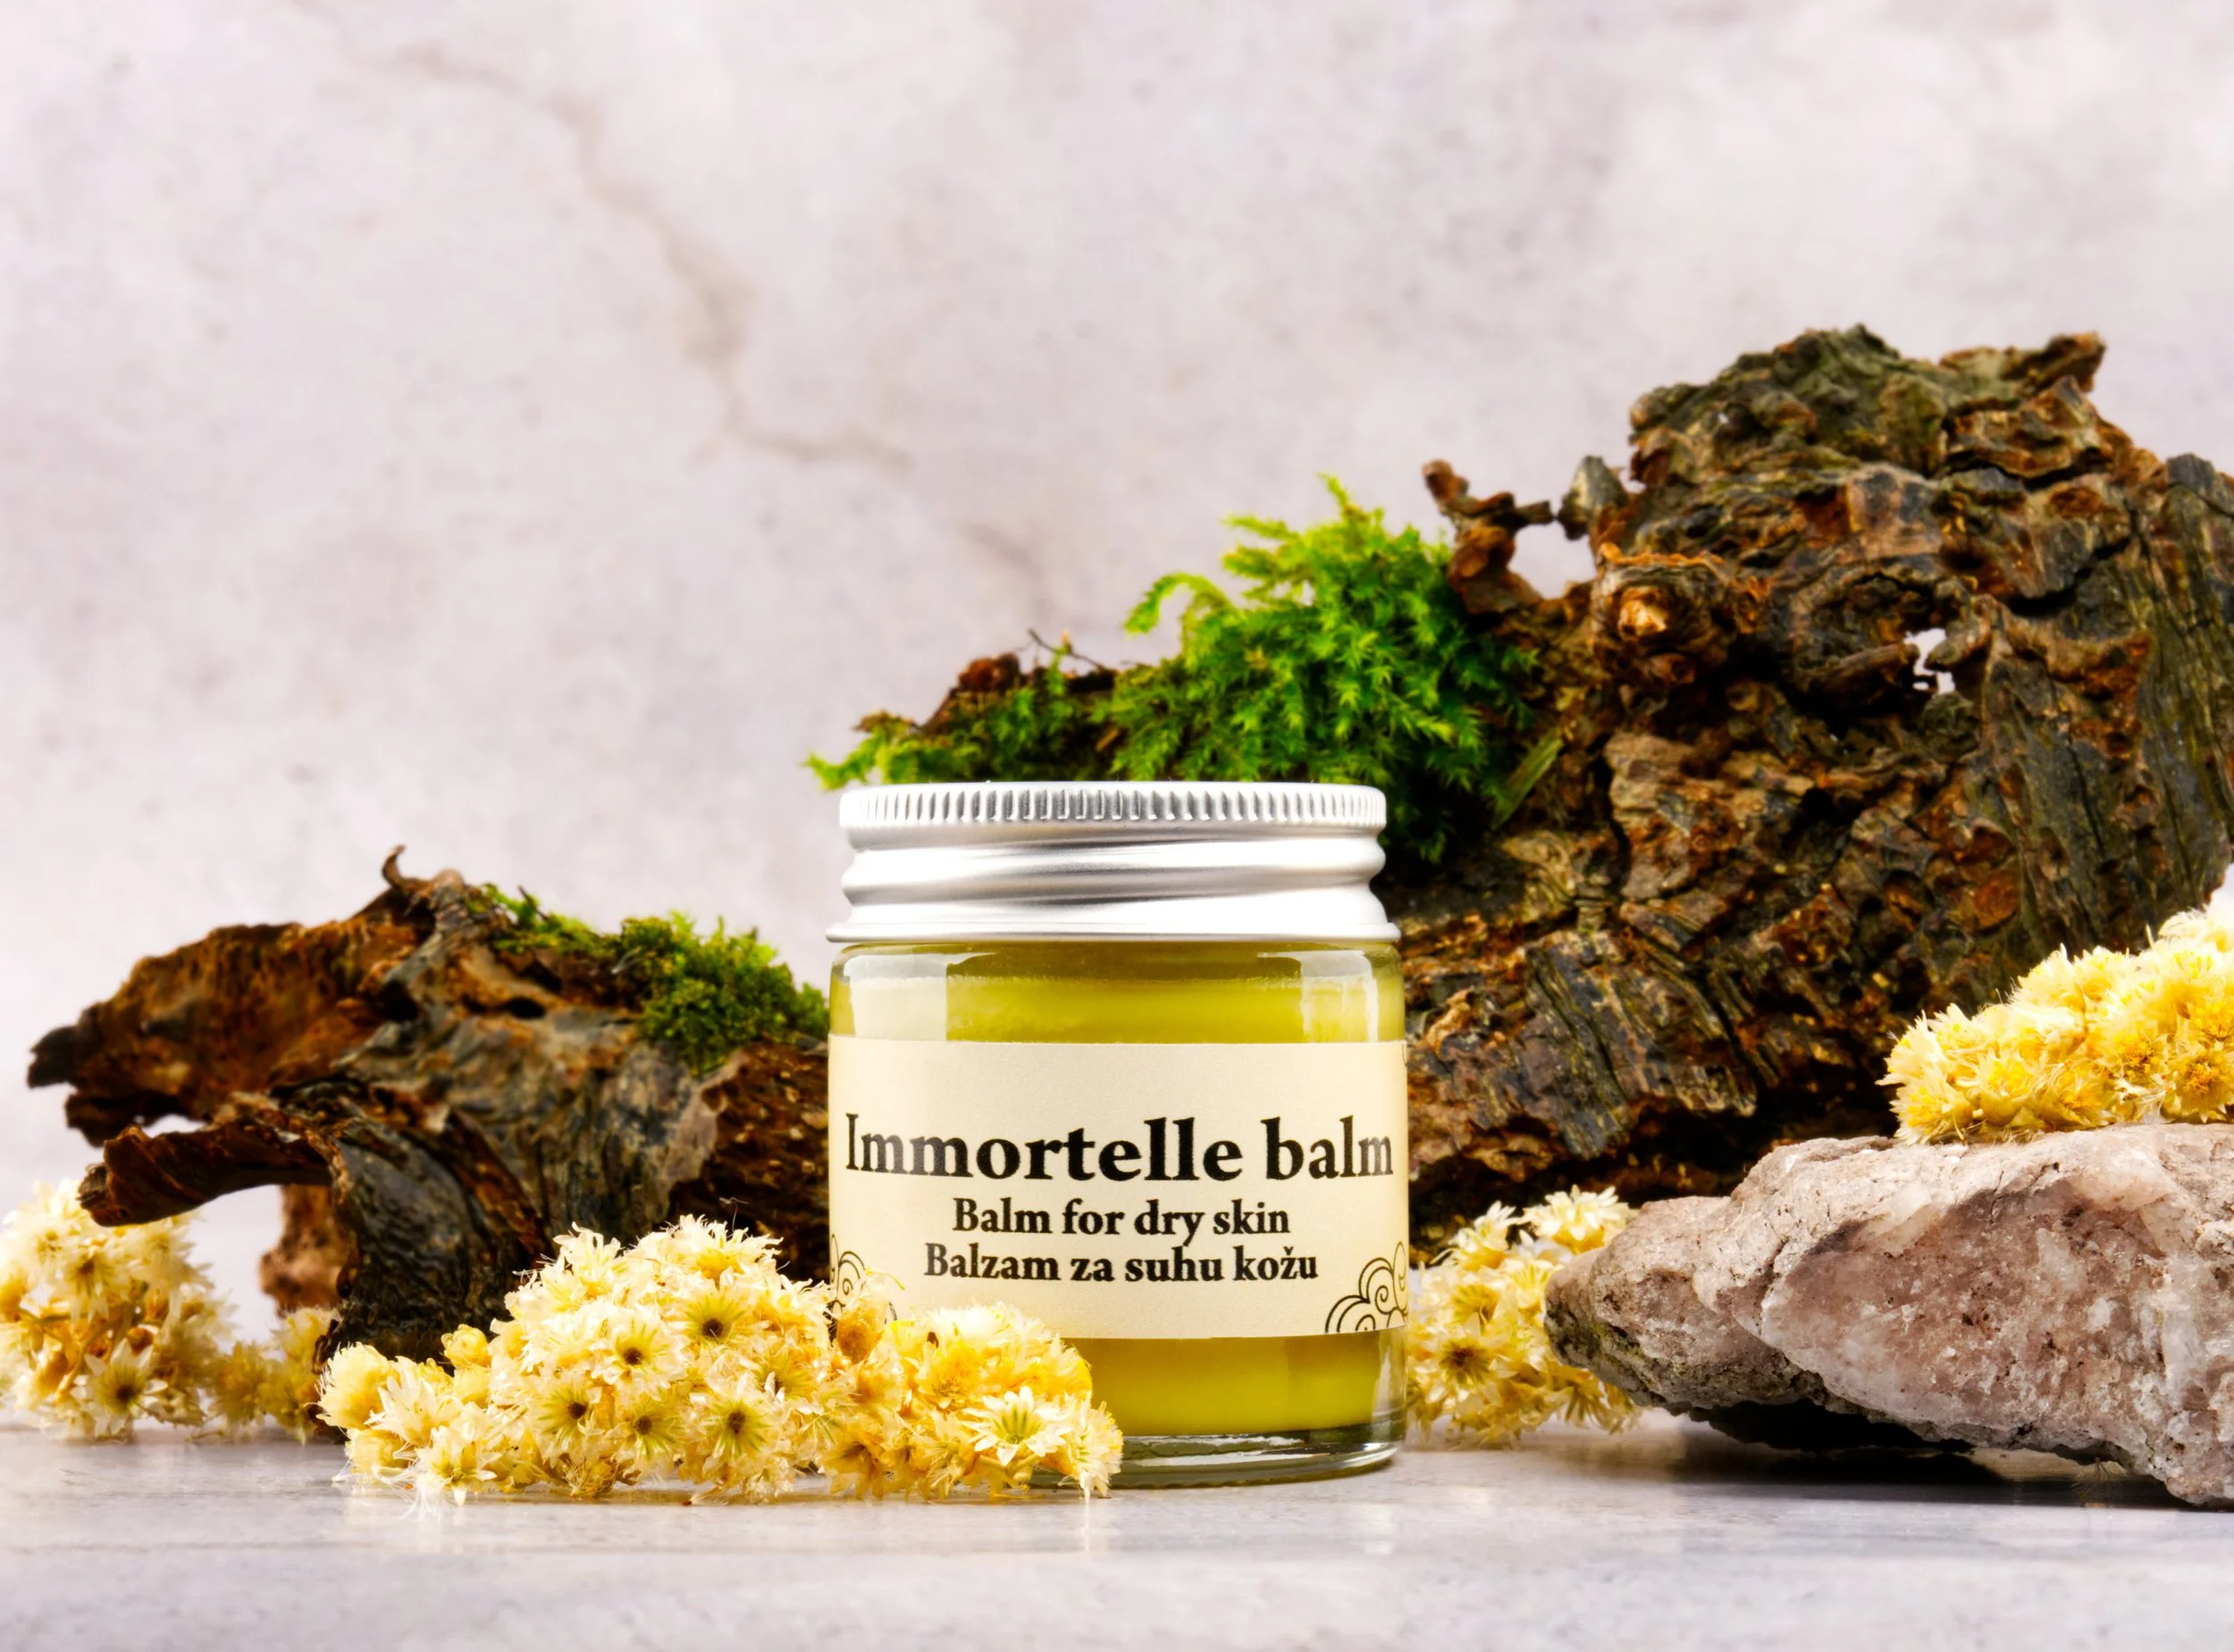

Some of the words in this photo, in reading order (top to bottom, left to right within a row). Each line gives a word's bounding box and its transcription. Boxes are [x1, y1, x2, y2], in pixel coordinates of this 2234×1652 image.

[845, 1113, 1244, 1182] Immortelle
[1259, 1115, 1394, 1180] balm
[953, 1196, 1053, 1234] Balm
[1062, 1197, 1126, 1236] for
[1133, 1198, 1205, 1247] dry
[1213, 1198, 1290, 1236] skin
[924, 1242, 1062, 1281] Balzam
[1071, 1258, 1115, 1282] za
[1124, 1245, 1225, 1282] suhu
[1233, 1245, 1319, 1281] kožu
